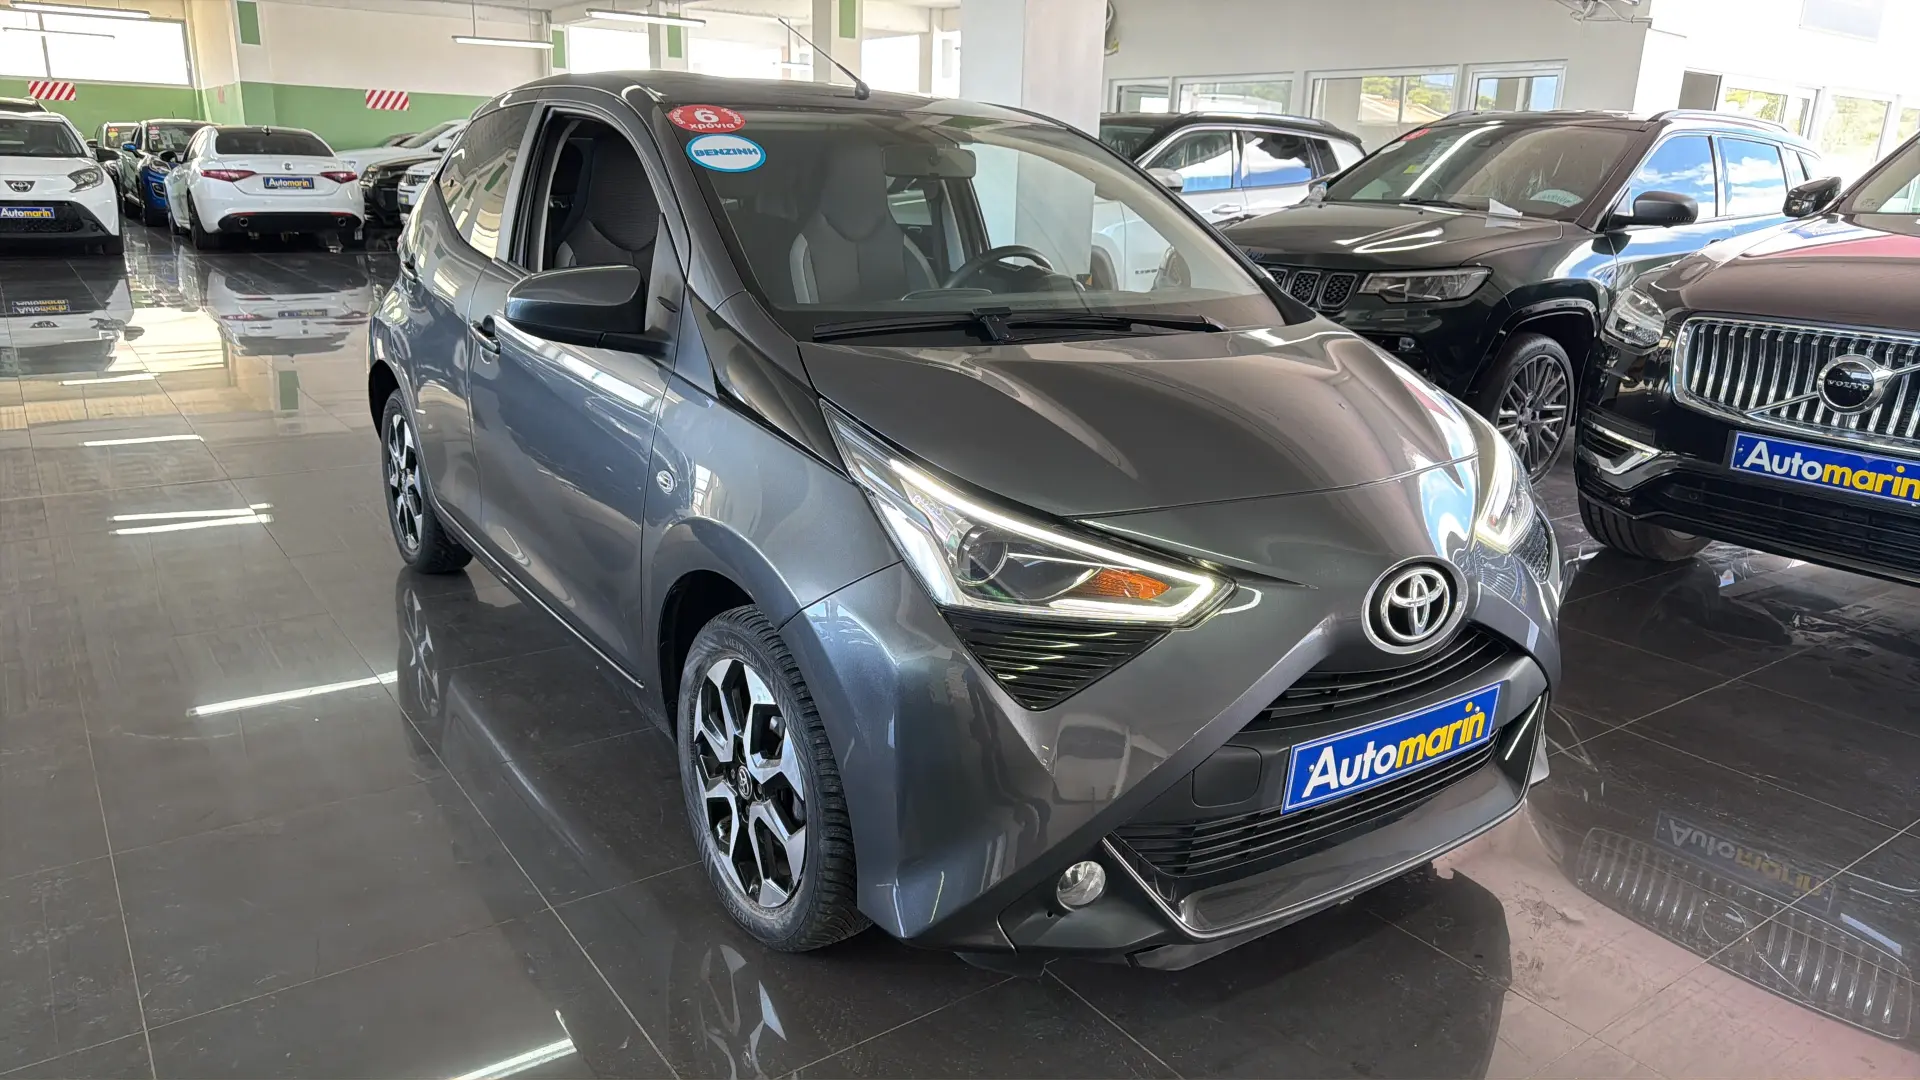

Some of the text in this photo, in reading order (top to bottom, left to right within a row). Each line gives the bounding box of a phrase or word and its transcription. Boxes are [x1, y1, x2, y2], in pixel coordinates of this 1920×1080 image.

[694, 110, 719, 123] 6
[689, 122, 736, 130] χρόνια
[268, 179, 310, 188] Automarin
[0, 207, 52, 217] Automarin
[1827, 379, 1870, 391] VOLVO
[1743, 441, 1920, 500] Automarin
[1301, 701, 1486, 798] Automarin
